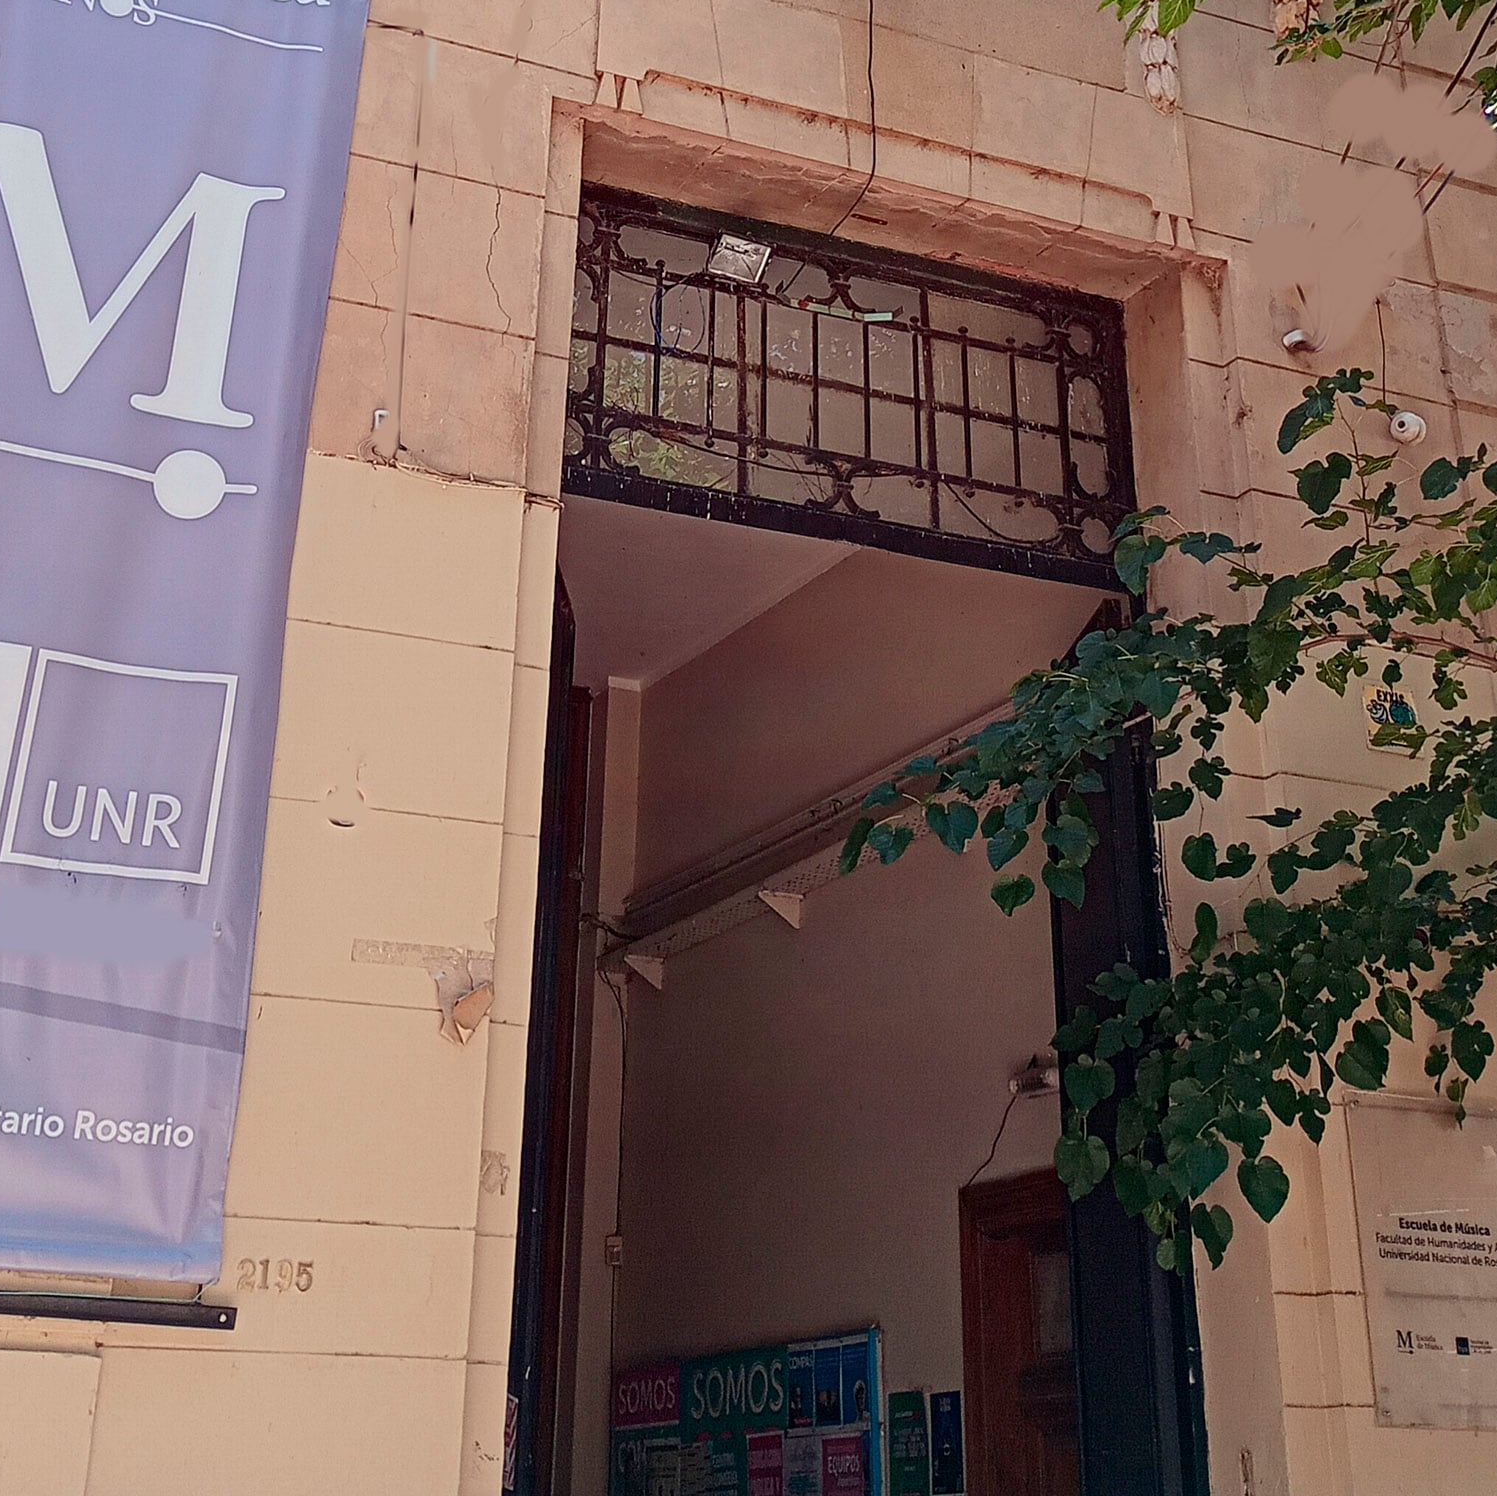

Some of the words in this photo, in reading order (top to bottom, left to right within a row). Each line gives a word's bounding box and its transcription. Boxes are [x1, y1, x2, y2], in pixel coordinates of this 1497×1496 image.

[41, 780, 183, 849] UNR
[72, 1109, 195, 1149] Rosario
[1399, 1217, 1438, 1232] Escuela
[1440, 1220, 1453, 1233] de
[1454, 1221, 1491, 1236] Música
[1375, 1232, 1412, 1246] Facultad
[1414, 1236, 1425, 1247] de
[1427, 1237, 1486, 1252] Humanidades
[1487, 1244, 1493, 1254] y
[1379, 1247, 1430, 1262] Universidad
[1431, 1252, 1470, 1265] Nacional
[1471, 1255, 1483, 1266] de
[236, 1257, 314, 1293] 2195
[1396, 1329, 1414, 1349] M
[618, 1375, 677, 1415] SOMOS
[690, 1359, 785, 1420] SOMOS
[827, 1454, 860, 1477] EQUIPOS
